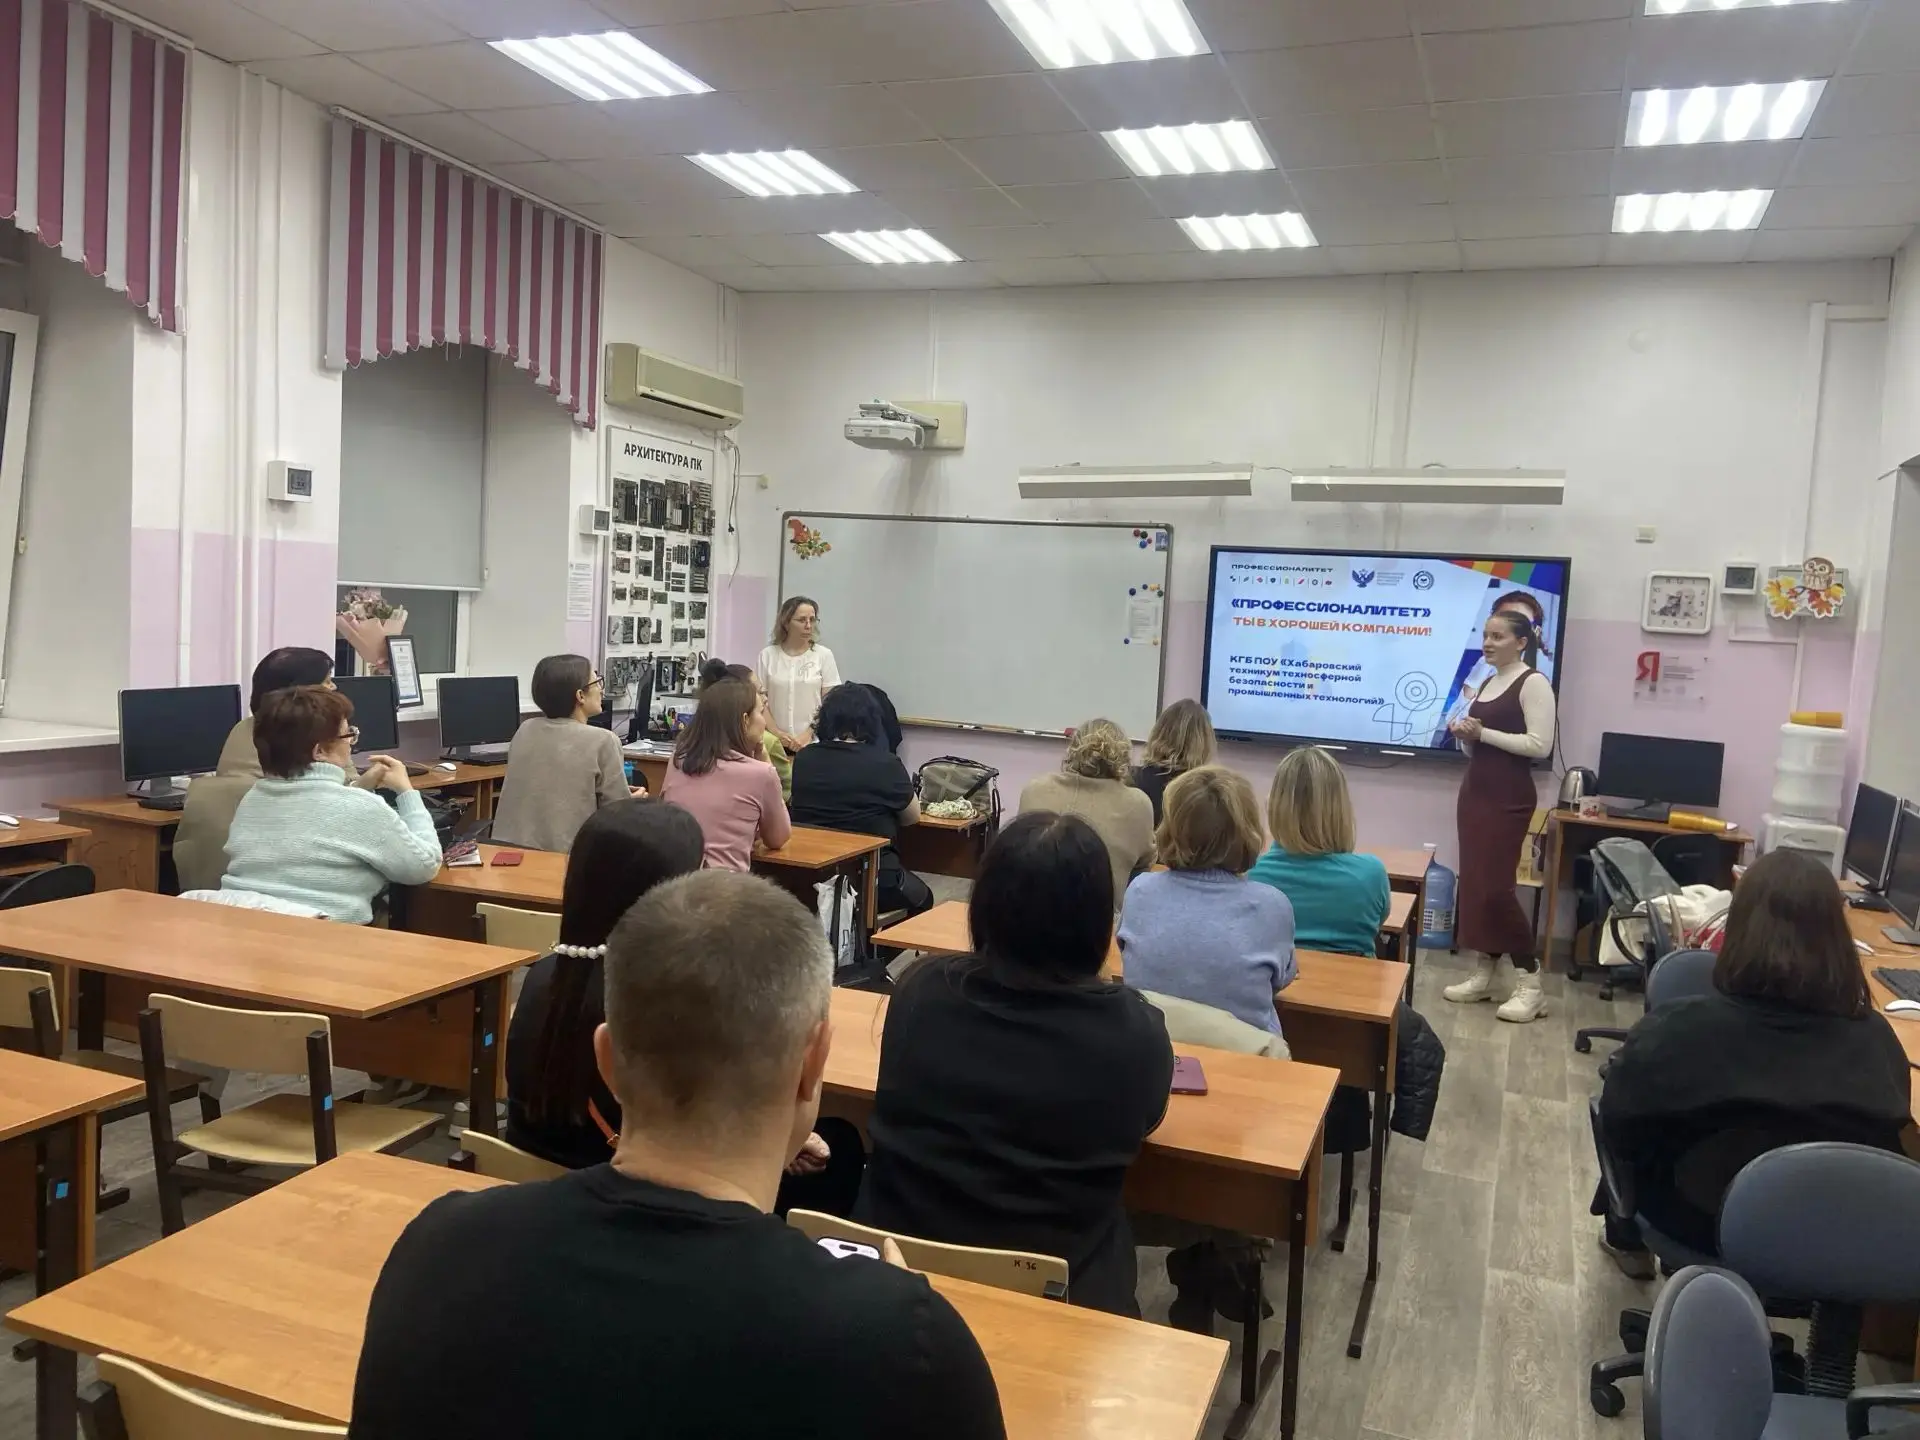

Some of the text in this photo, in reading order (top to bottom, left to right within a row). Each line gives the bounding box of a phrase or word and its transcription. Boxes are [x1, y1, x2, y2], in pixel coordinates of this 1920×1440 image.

[624, 442, 702, 471] АРХИТЕКТУРА ПК
[1231, 564, 1334, 573] ПРОФЕССИОНАЛИТЕТ
[1231, 598, 1431, 618] «ПРОФЕССИОНАЛИТЕТ»
[1233, 616, 1432, 636] ТЫ В ХОРОШЕЙ КОМПАНИИ!
[1229, 655, 1362, 671] КГБ ПОУ «Хабаровский
[1635, 651, 1660, 682] Я
[1229, 666, 1361, 682] техникум техносферной
[1229, 676, 1306, 689] безопасности
[1228, 687, 1385, 705] промышленных технологий»
